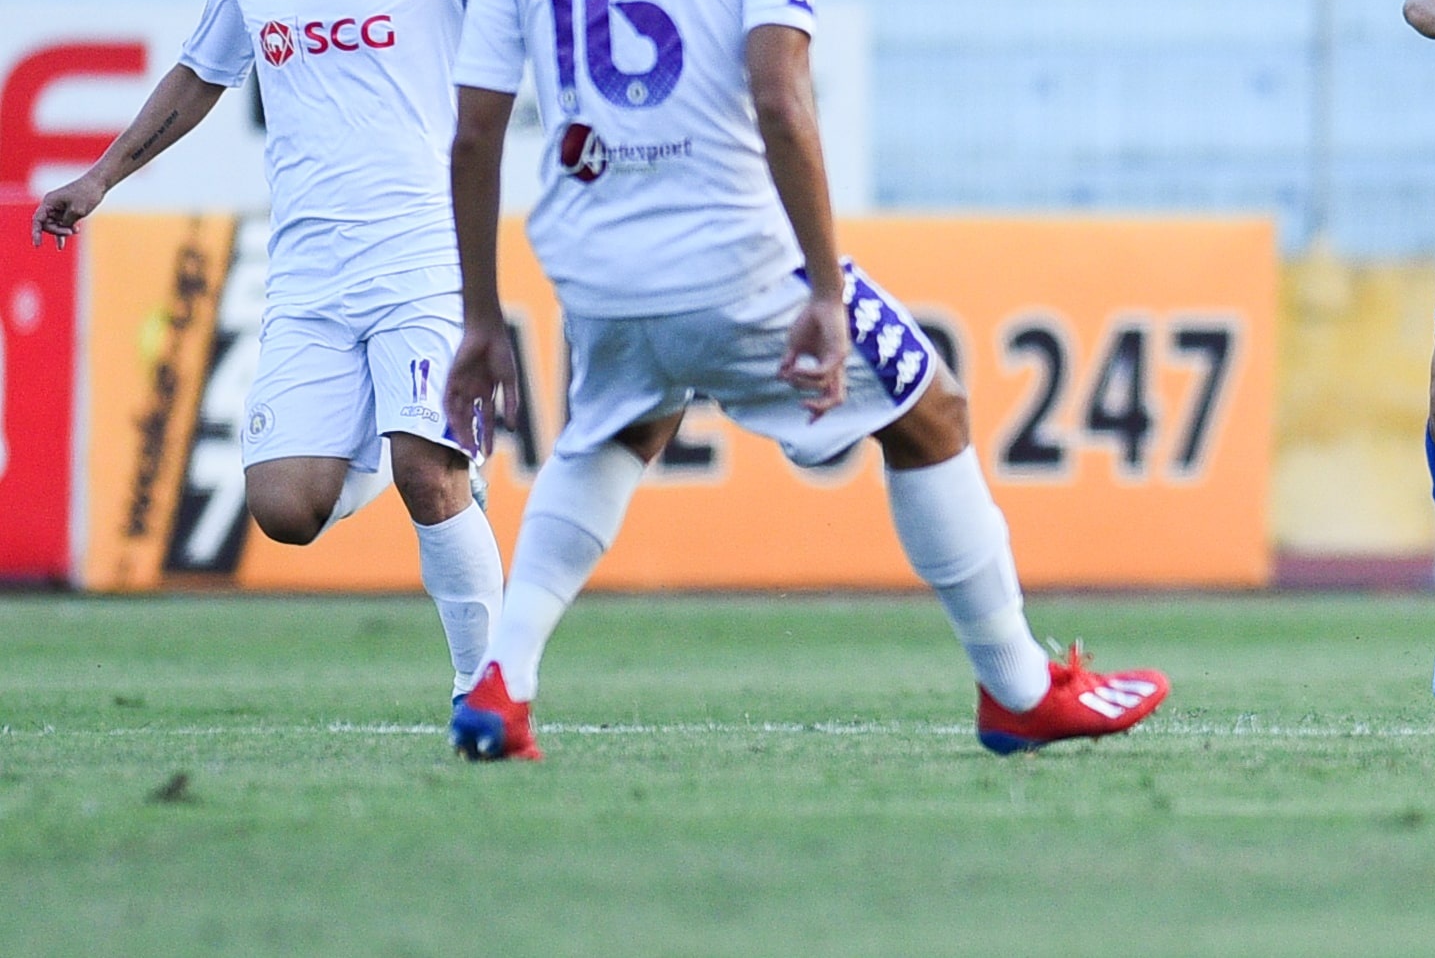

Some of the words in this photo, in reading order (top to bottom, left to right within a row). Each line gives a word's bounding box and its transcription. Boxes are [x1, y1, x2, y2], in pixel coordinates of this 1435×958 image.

[303, 14, 396, 55] SCG
[410, 358, 430, 403] 11
[1006, 326, 1232, 468] 247
